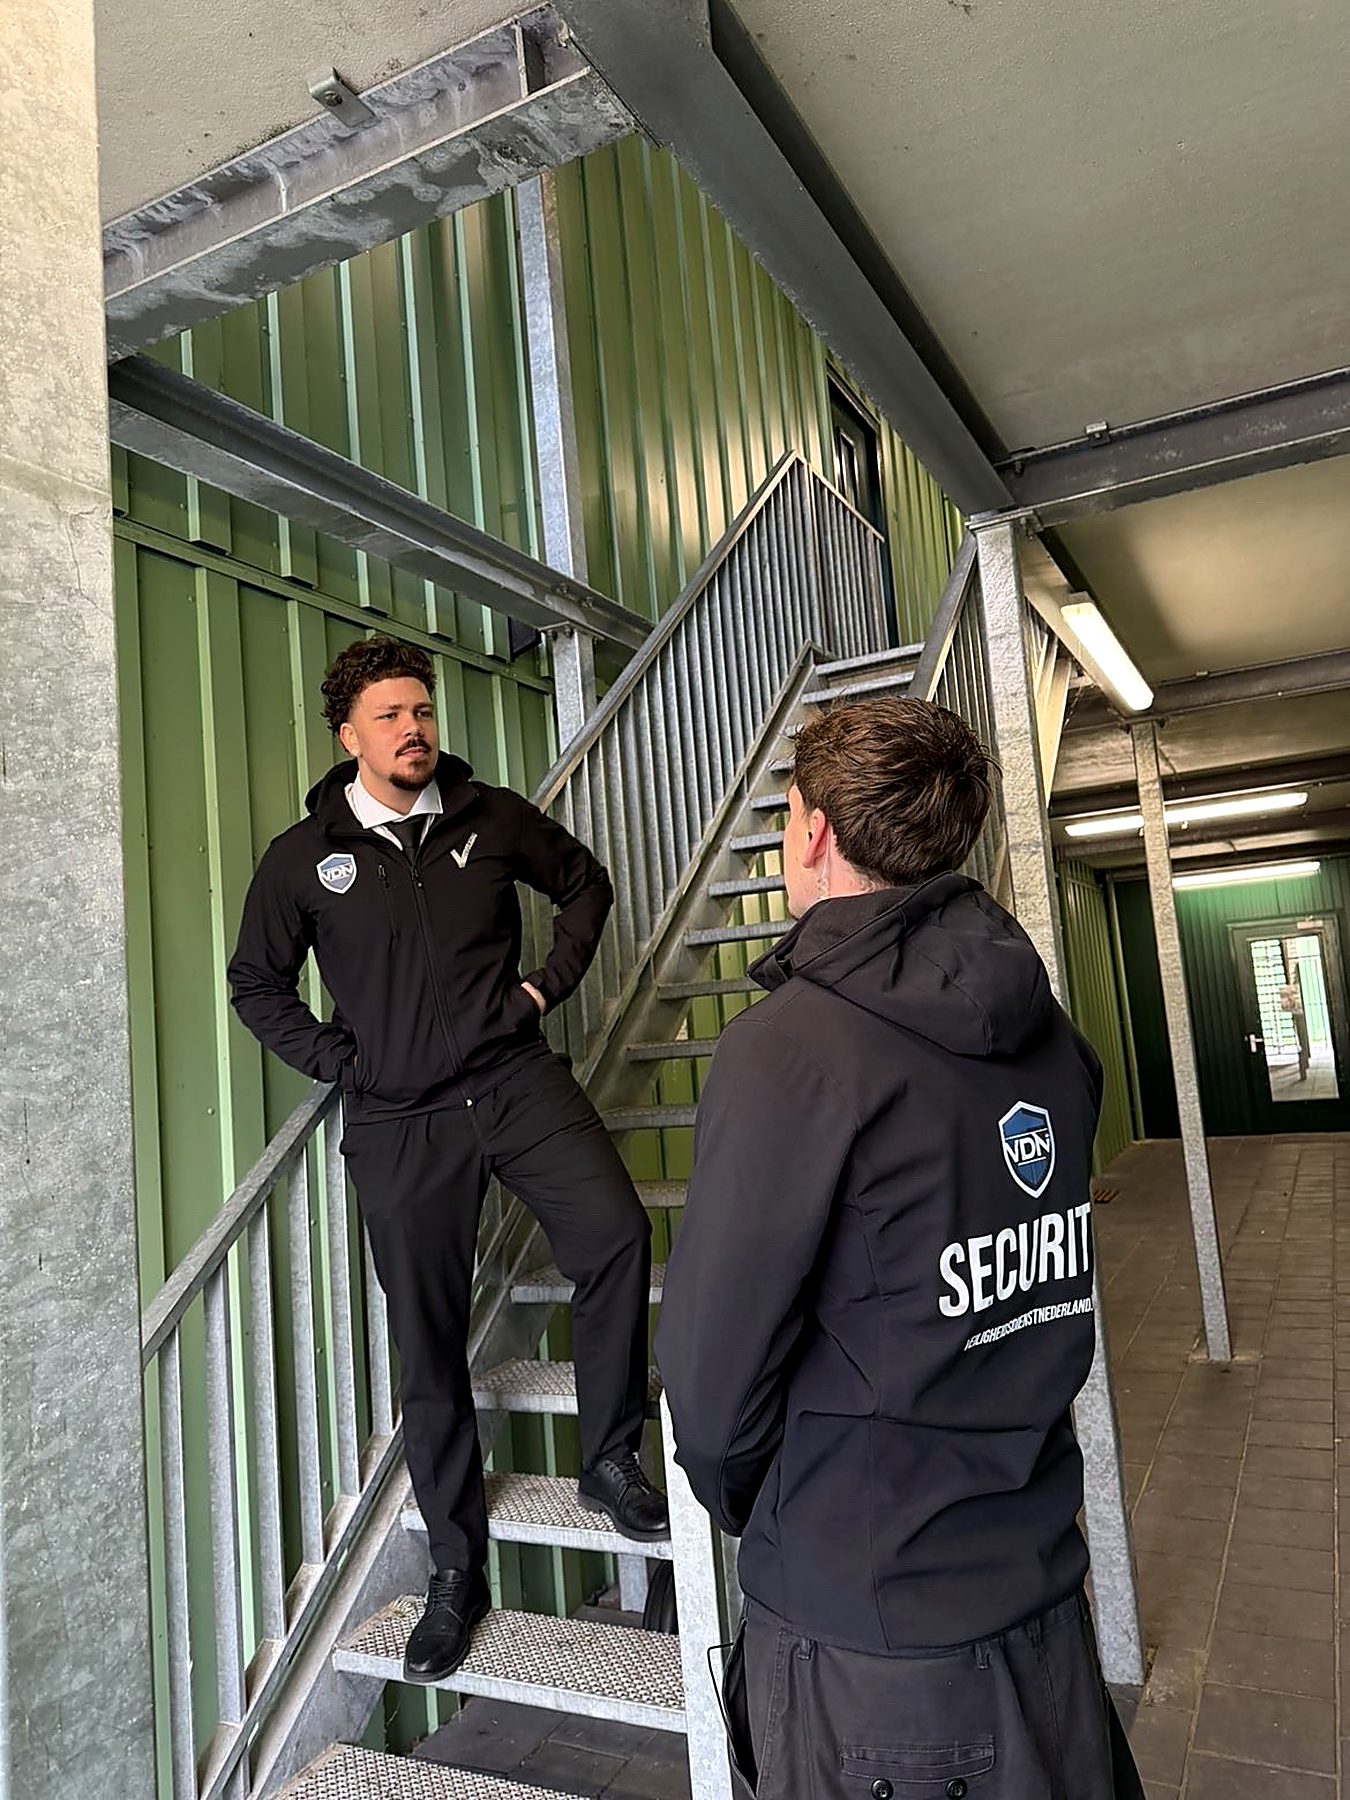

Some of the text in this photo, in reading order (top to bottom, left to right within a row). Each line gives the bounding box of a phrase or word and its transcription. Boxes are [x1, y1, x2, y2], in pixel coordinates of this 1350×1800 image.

[320, 863, 354, 881] VDN
[1005, 1131, 1050, 1163] VDN
[938, 1201, 1091, 1317] SECURIT
